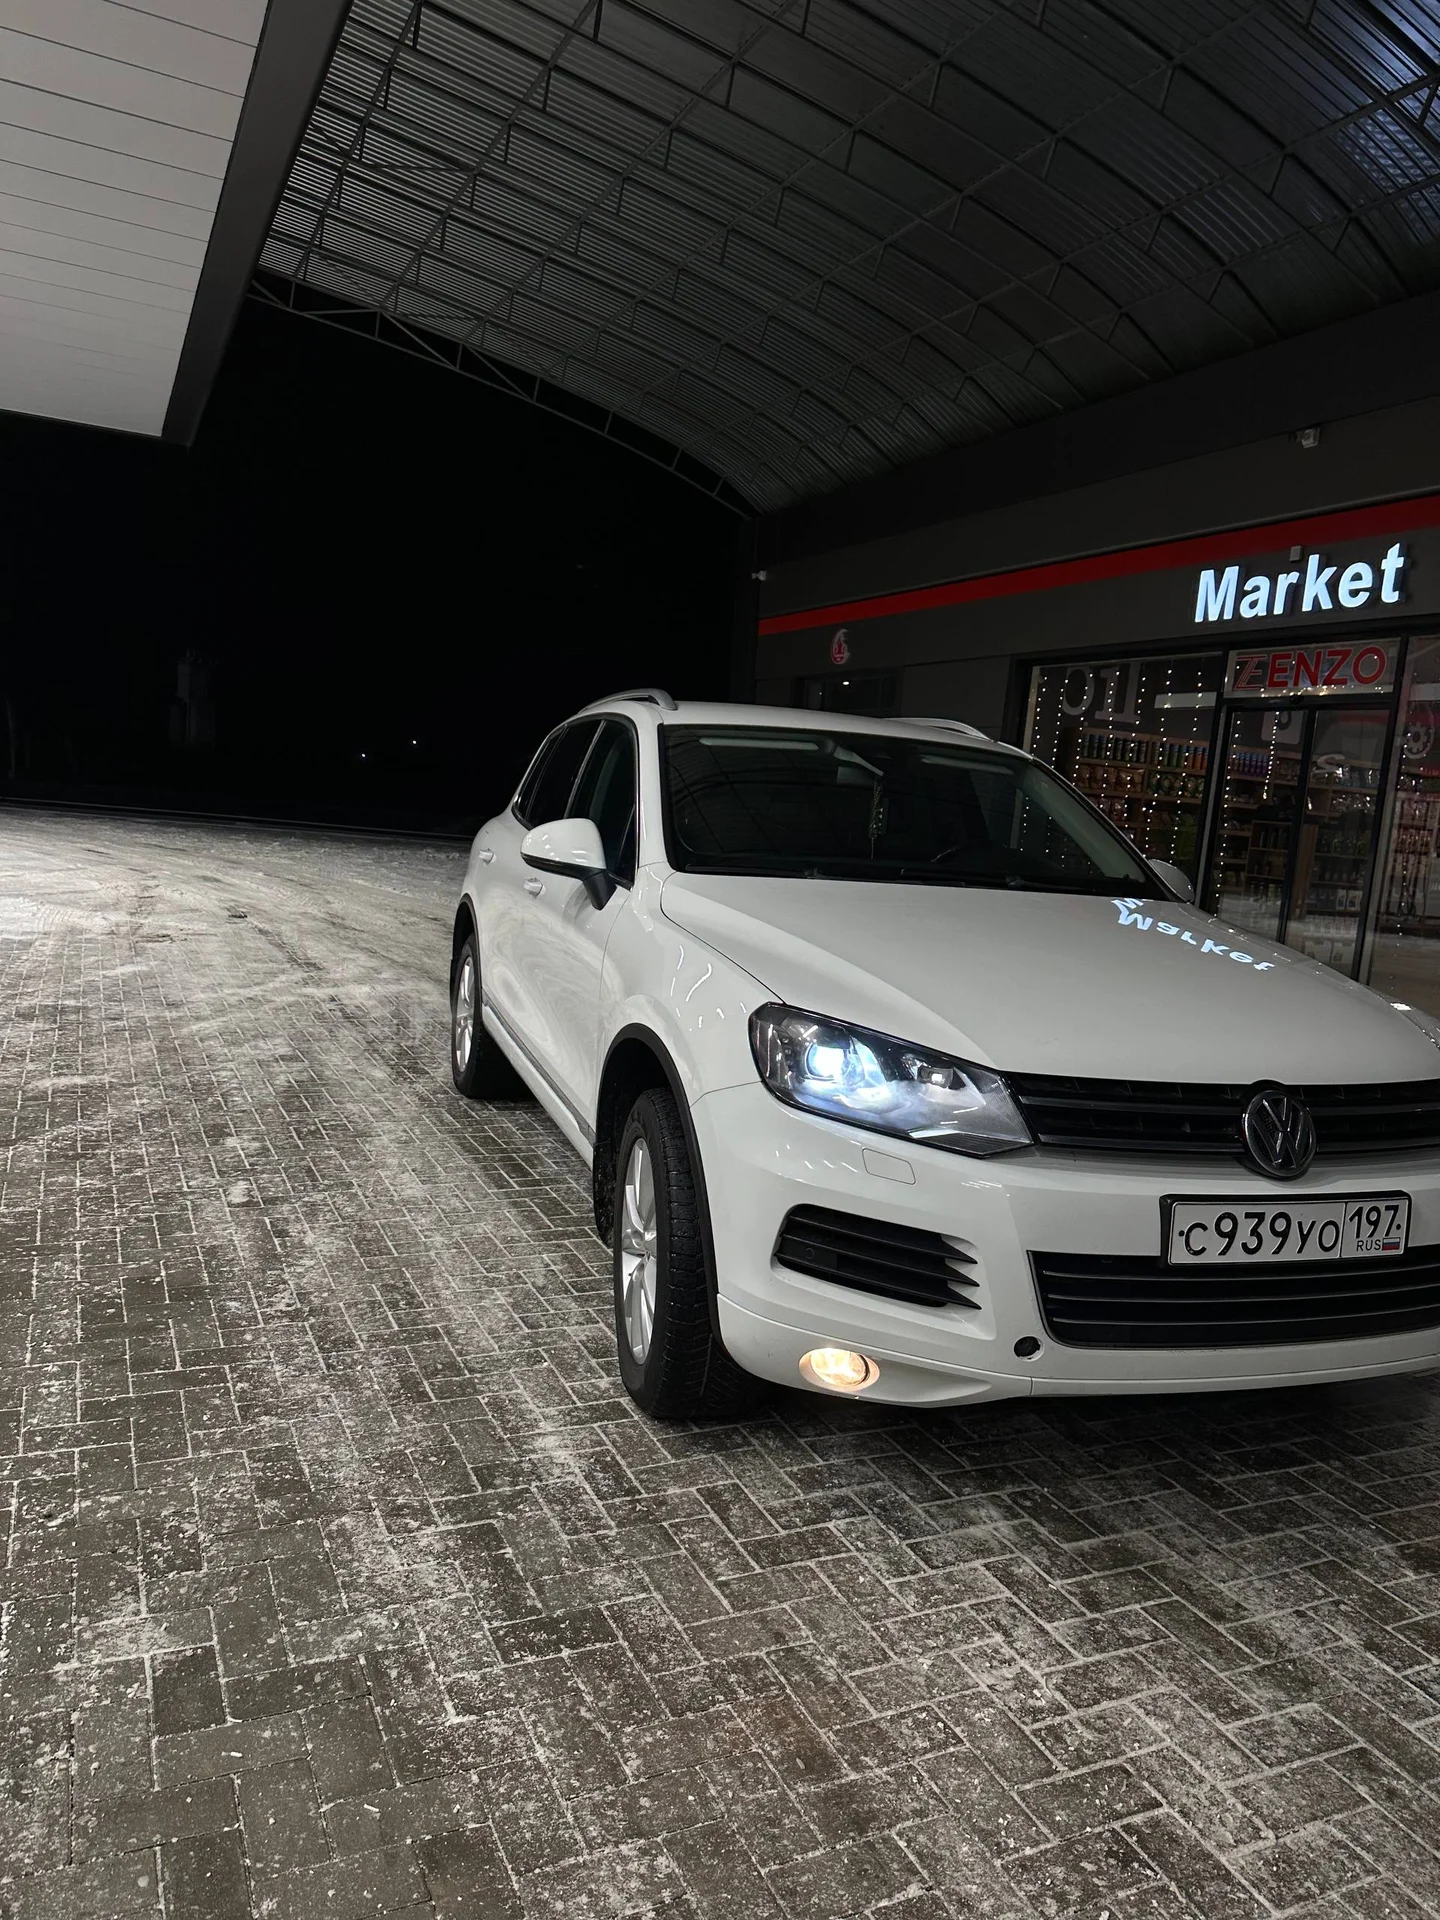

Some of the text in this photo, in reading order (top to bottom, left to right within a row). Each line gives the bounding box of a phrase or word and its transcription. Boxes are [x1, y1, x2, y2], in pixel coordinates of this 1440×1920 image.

[1195, 543, 1404, 622] Market
[1233, 646, 1387, 692] ZENZO
[1348, 1204, 1400, 1239] 197
[1355, 1239, 1381, 1252] RUS
